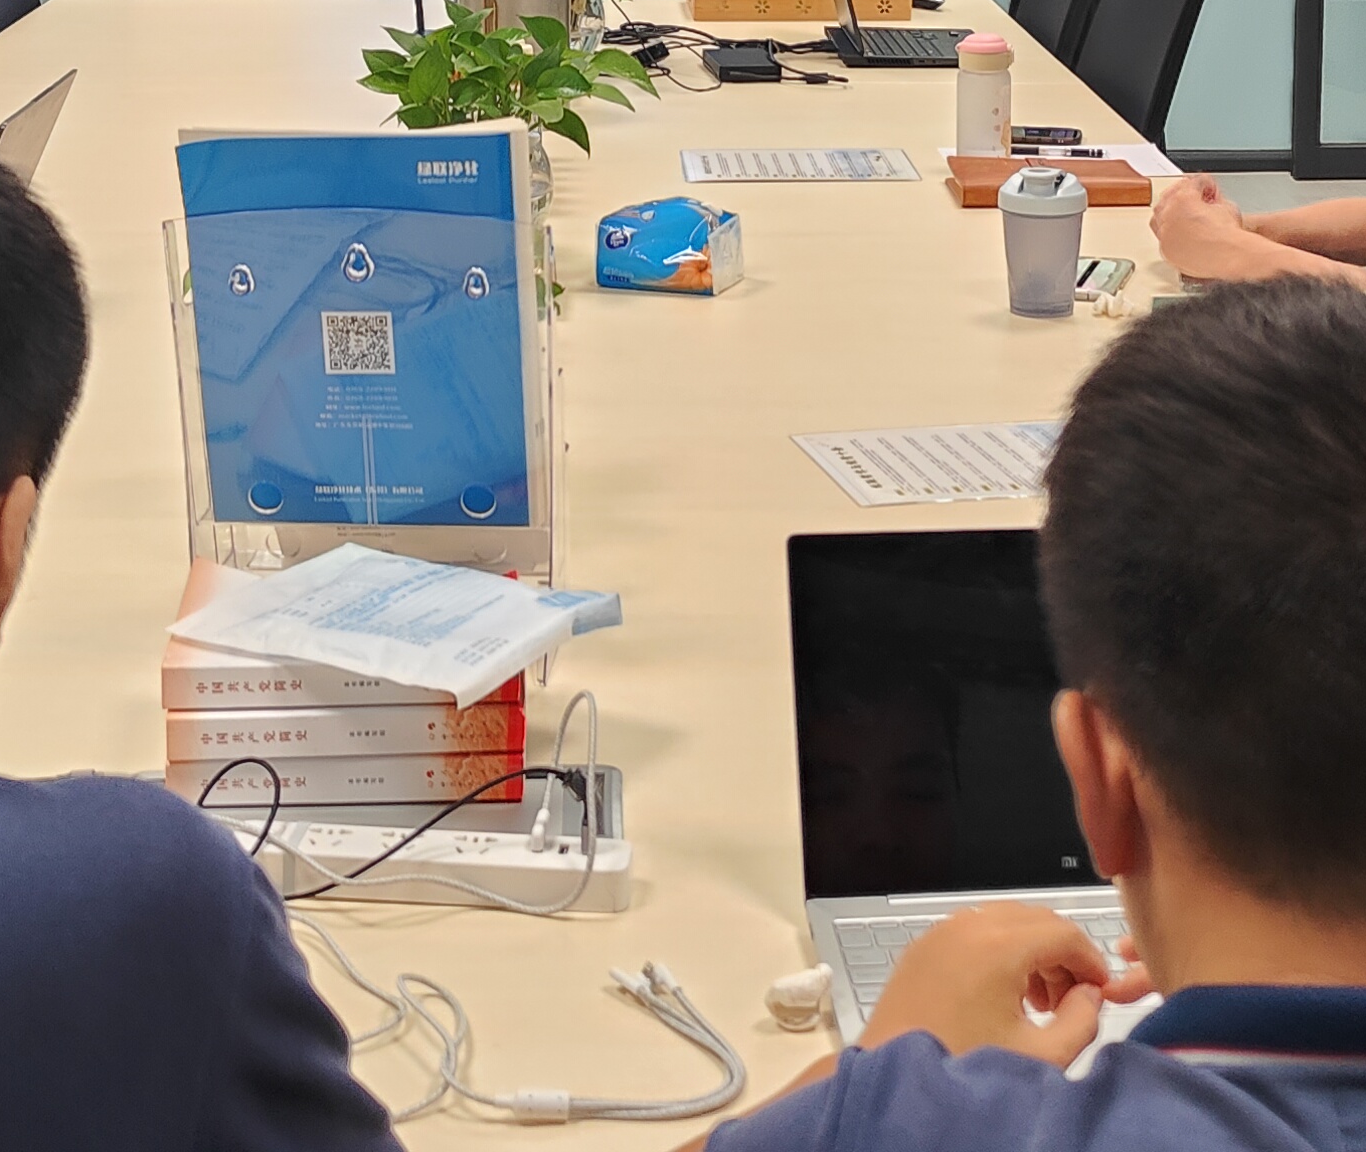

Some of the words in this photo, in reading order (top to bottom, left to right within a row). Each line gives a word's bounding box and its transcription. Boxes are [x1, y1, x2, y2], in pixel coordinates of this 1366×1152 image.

[196, 679, 303, 694] 中国共产党简史
[200, 729, 308, 745] 中国共产党简史
